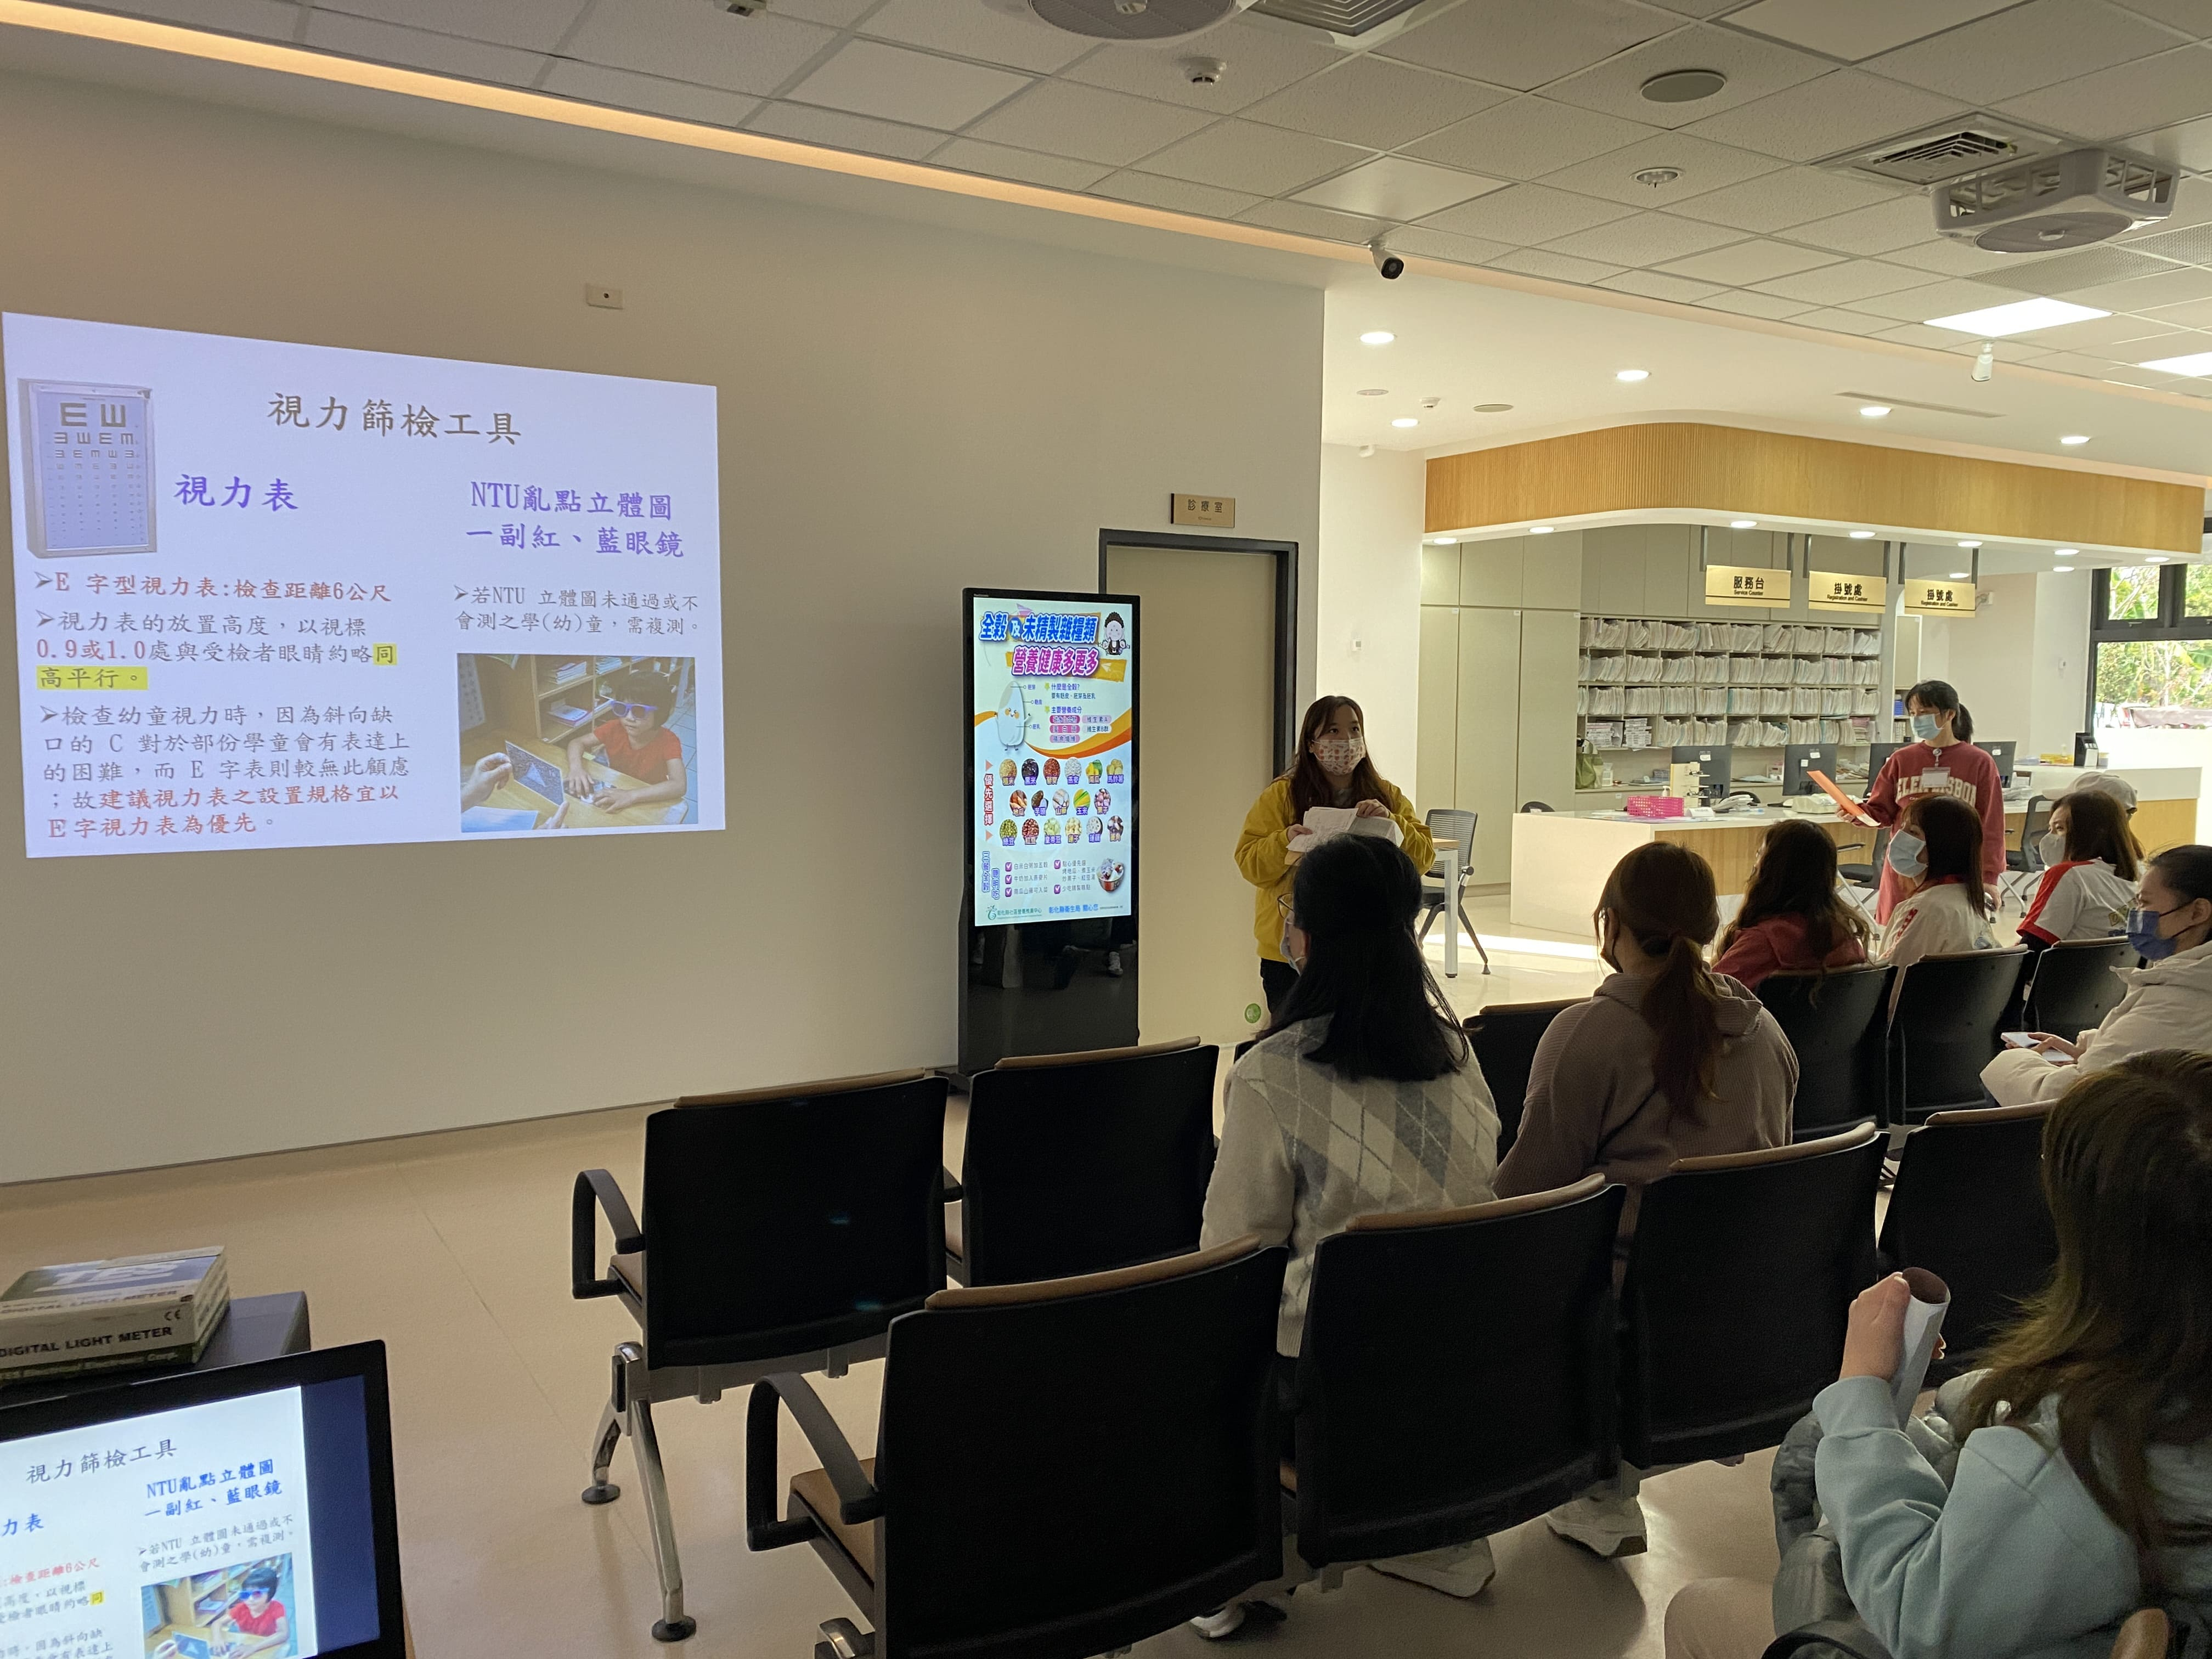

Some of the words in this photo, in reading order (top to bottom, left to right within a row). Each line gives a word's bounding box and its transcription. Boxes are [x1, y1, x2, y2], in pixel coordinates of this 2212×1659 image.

[267, 392, 522, 445] 視力篩檢工具
[173, 473, 299, 512] 視力表
[470, 481, 672, 521] NTU亂點立體圖
[1187, 499, 1223, 513] 診療室
[465, 523, 685, 558] 一副紅、藍眼鏡
[1733, 575, 1765, 590] 服務台
[1833, 582, 1863, 596] 掛號處
[1927, 589, 1954, 602] 掛號處
[538, 588, 699, 611] 立體圖未通過或不
[1012, 646, 1099, 676] 營養健康多更多
[0, 1342, 59, 1358] DIGITAL
[65, 1335, 112, 1349] LIGHT
[118, 1326, 172, 1343] METER
[26, 1438, 177, 1485] 視力篩檢工具
[146, 1458, 274, 1499] NTU亂點立體圖
